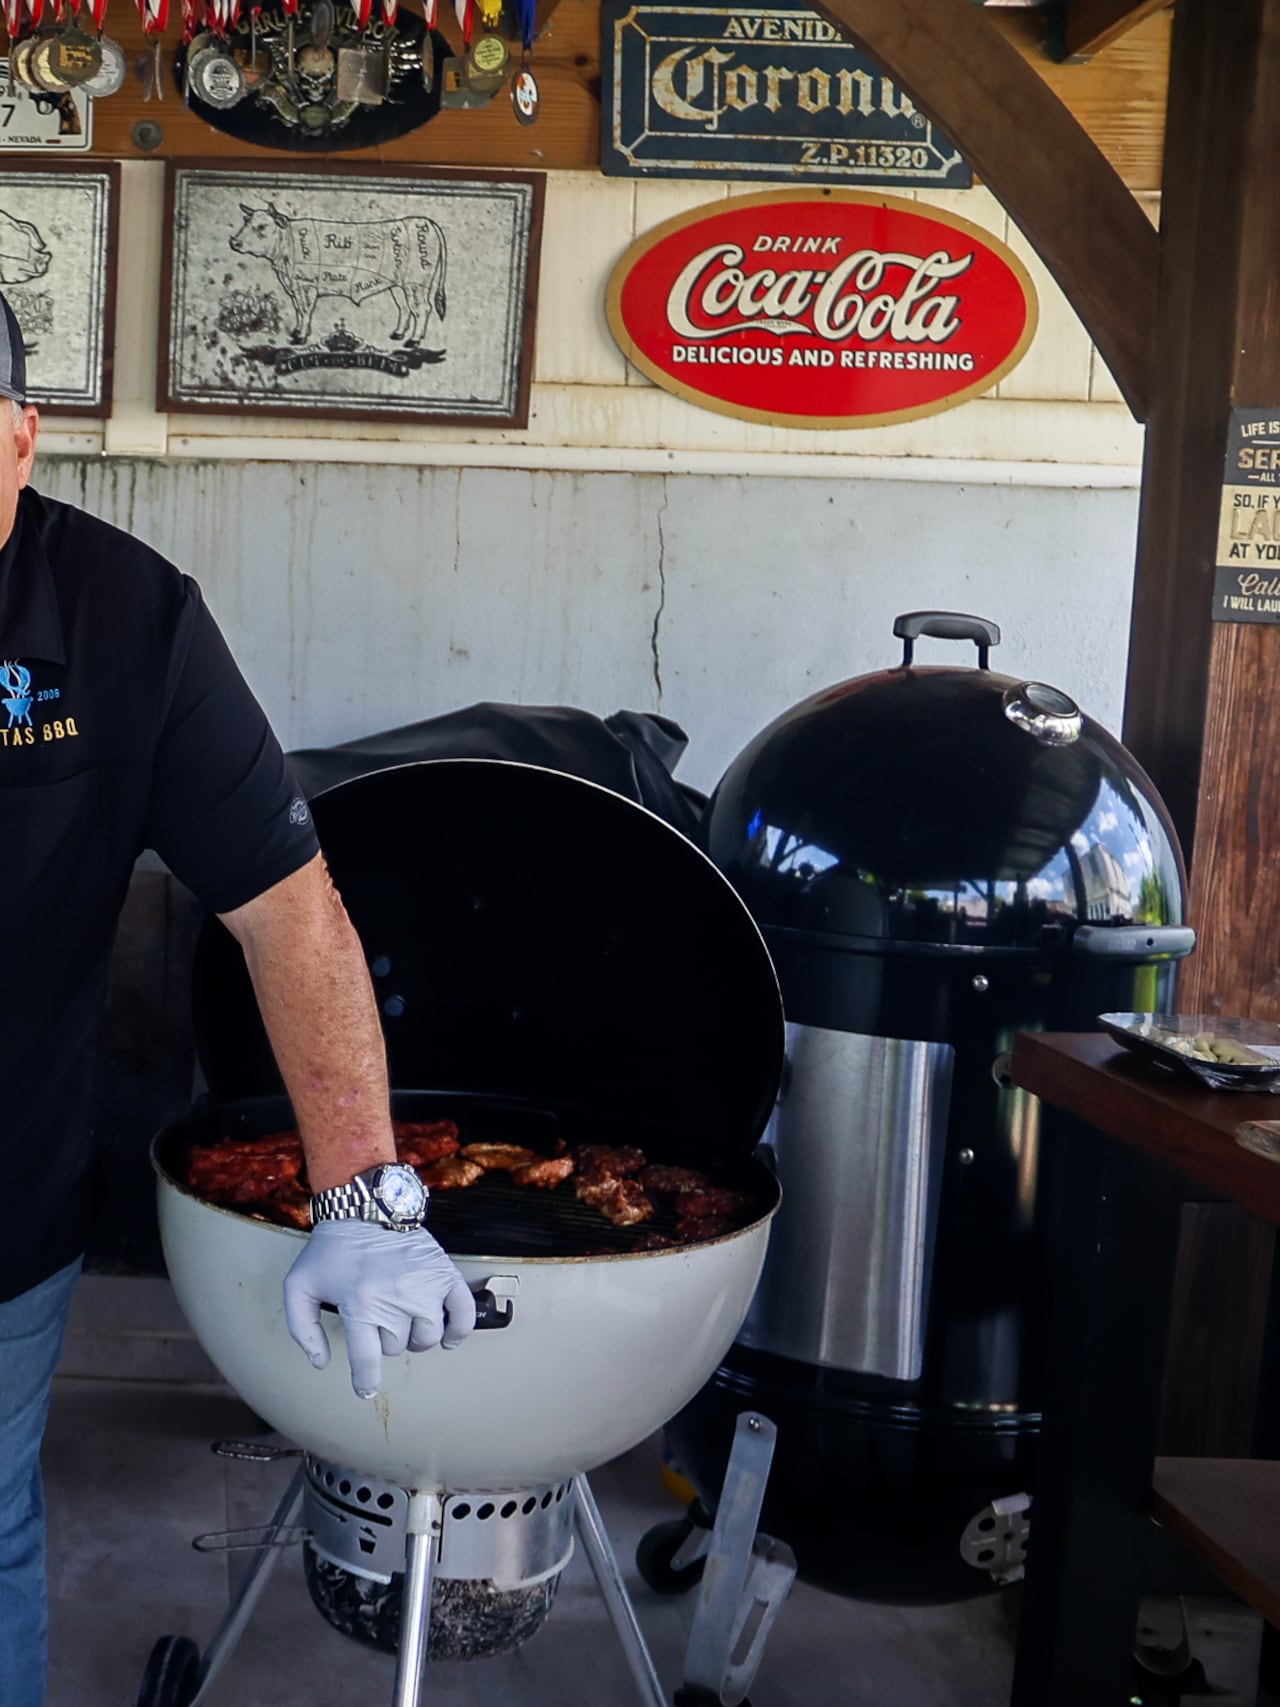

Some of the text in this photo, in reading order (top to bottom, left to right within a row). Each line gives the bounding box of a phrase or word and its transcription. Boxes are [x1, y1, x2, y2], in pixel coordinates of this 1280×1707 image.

[723, 17, 843, 42] AVENID
[8, 136, 42, 144] NEVADA
[800, 142, 929, 169] Z.P.11320
[324, 233, 354, 249] Rib
[415, 222, 432, 270] Round
[752, 236, 843, 254] DRINK
[667, 243, 975, 342] Coca-Cola
[672, 345, 975, 371] DELICIOUS AND REFRESHING
[1240, 421, 1280, 438] LIFE IS
[1260, 472, 1276, 482] ALL
[1257, 494, 1269, 509] IF
[1229, 542, 1280, 560] AT YO
[1223, 595, 1280, 612] I WILL LAU
[42, 717, 79, 741] BBQ
